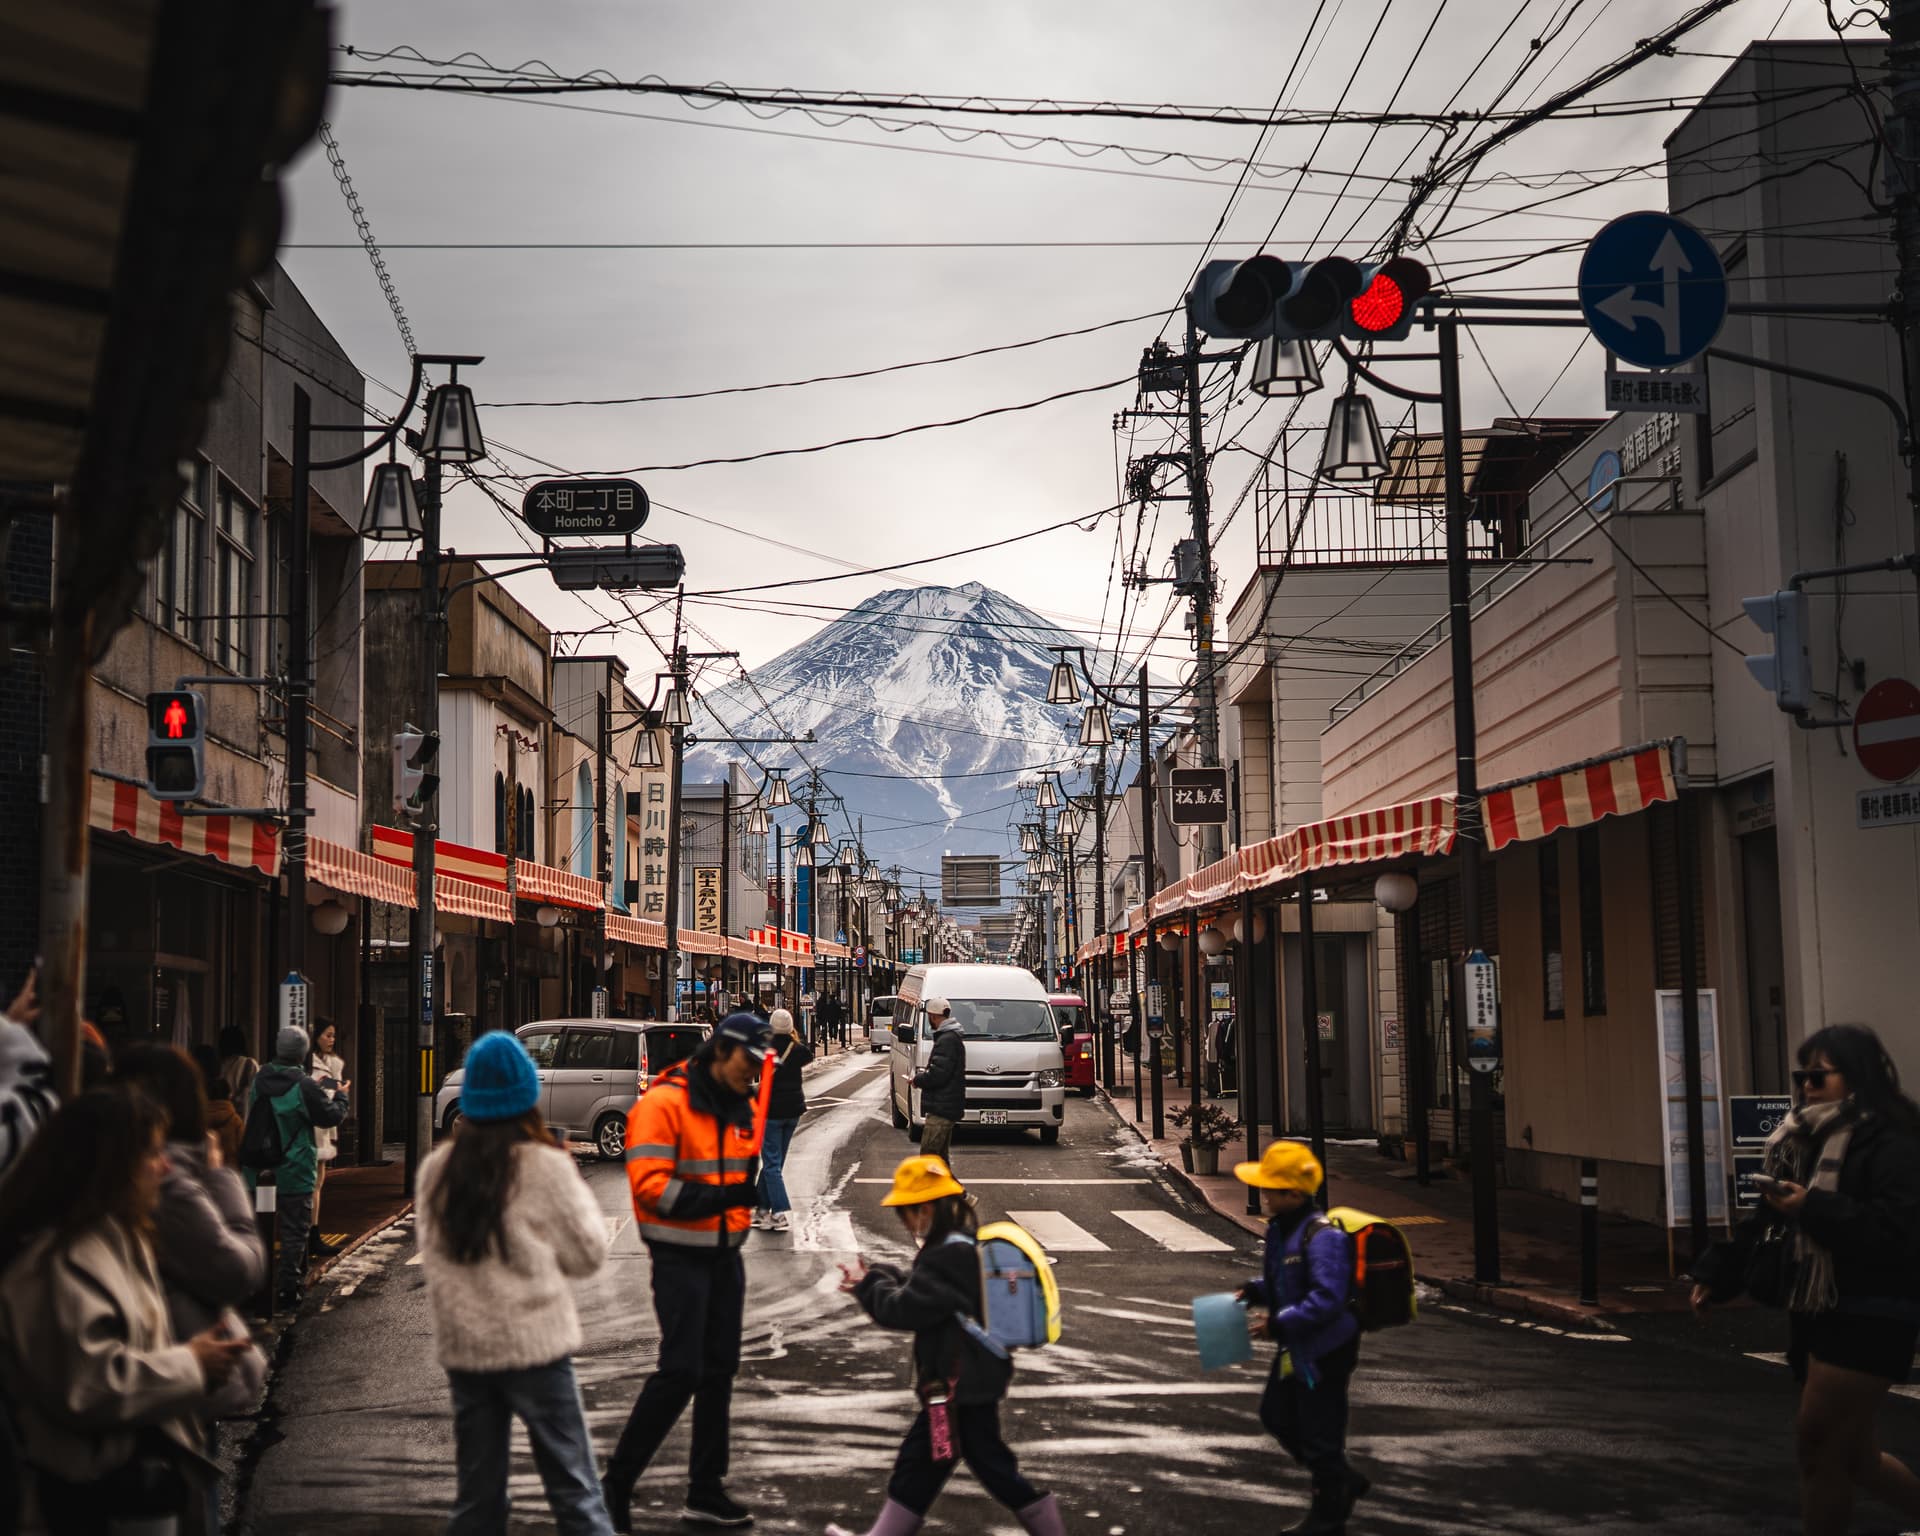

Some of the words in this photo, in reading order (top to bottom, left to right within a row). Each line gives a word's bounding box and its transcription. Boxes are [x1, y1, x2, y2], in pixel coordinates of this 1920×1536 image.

[536, 488, 633, 512] 本町二丁目
[555, 515, 602, 528] Honcho
[607, 514, 616, 526] 2
[1175, 788, 1224, 805] 松島屋
[644, 782, 666, 913] 日川時計店
[1757, 1102, 1790, 1111] PARKING
